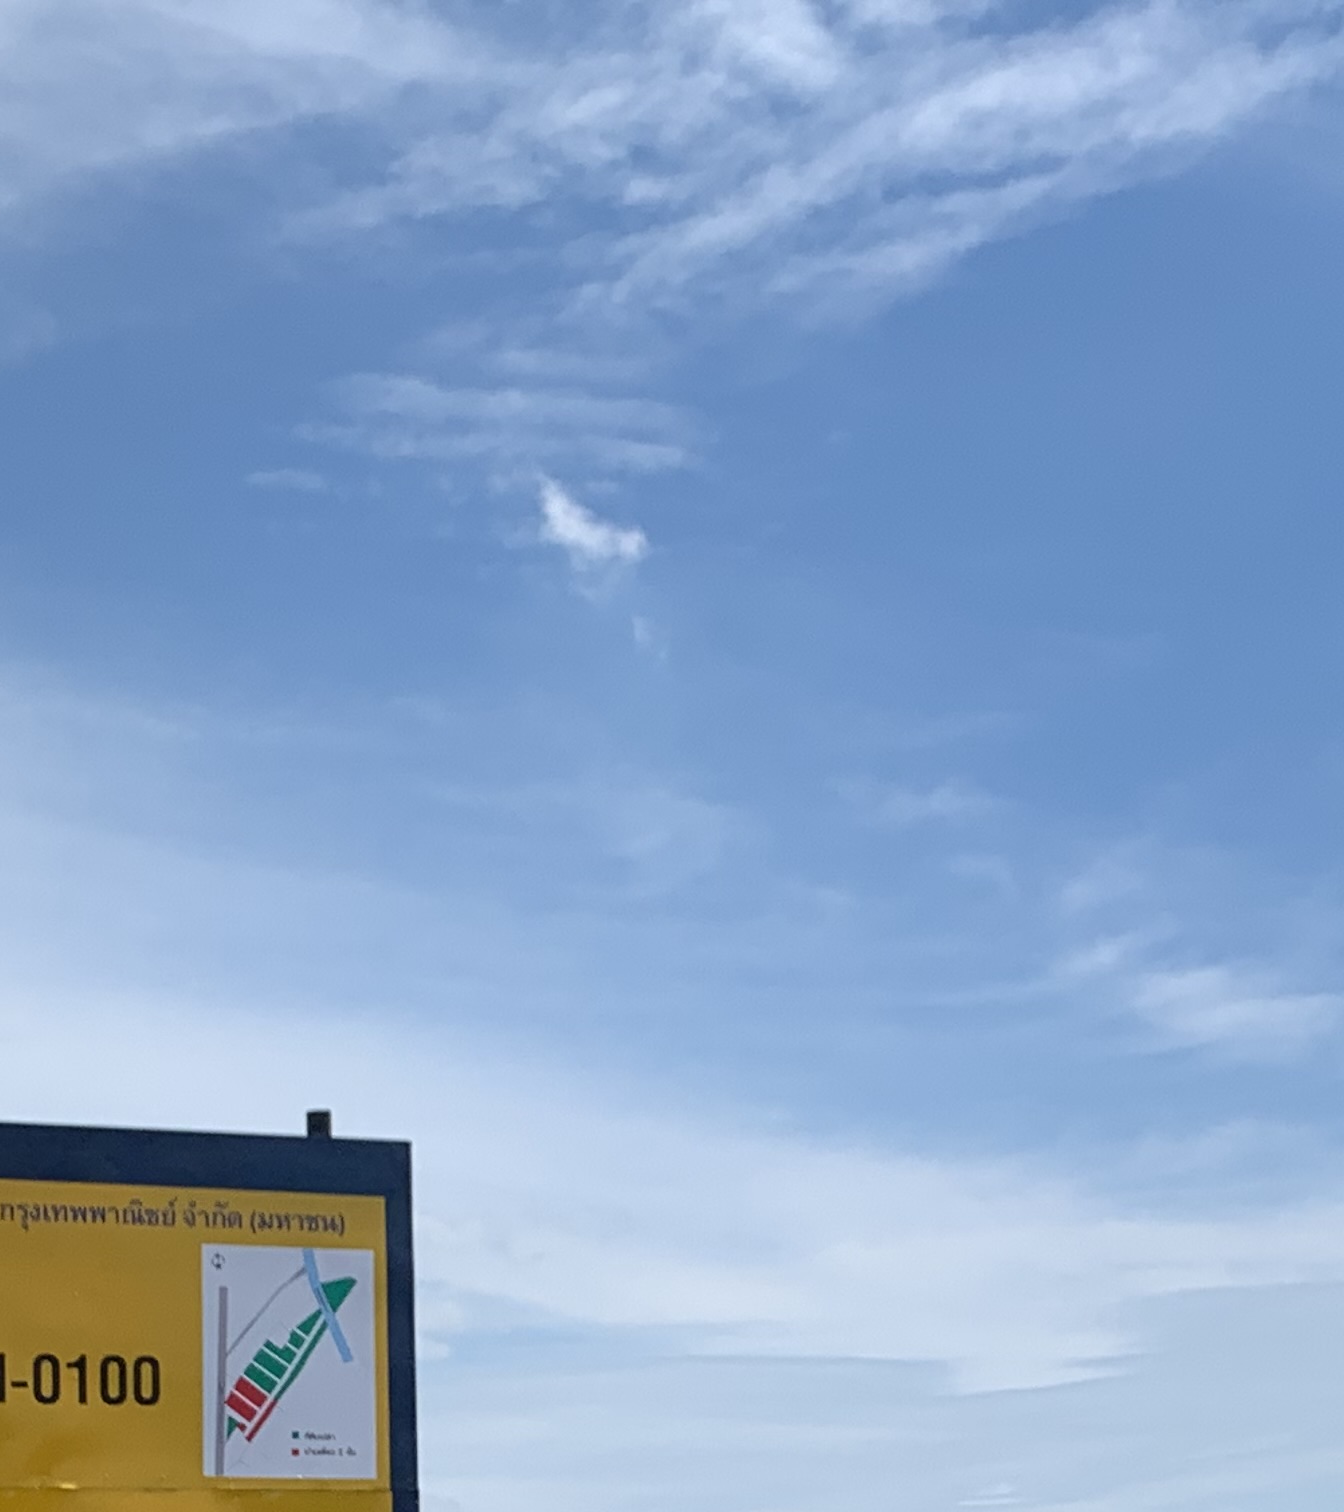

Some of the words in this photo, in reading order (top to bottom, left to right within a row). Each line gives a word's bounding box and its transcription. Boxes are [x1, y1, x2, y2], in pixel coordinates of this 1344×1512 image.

[0, 1196, 178, 1232] กรุงเทพพาณิชย์
[183, 1200, 243, 1229] จำกัด
[249, 1210, 346, 1237] (มหาชน)
